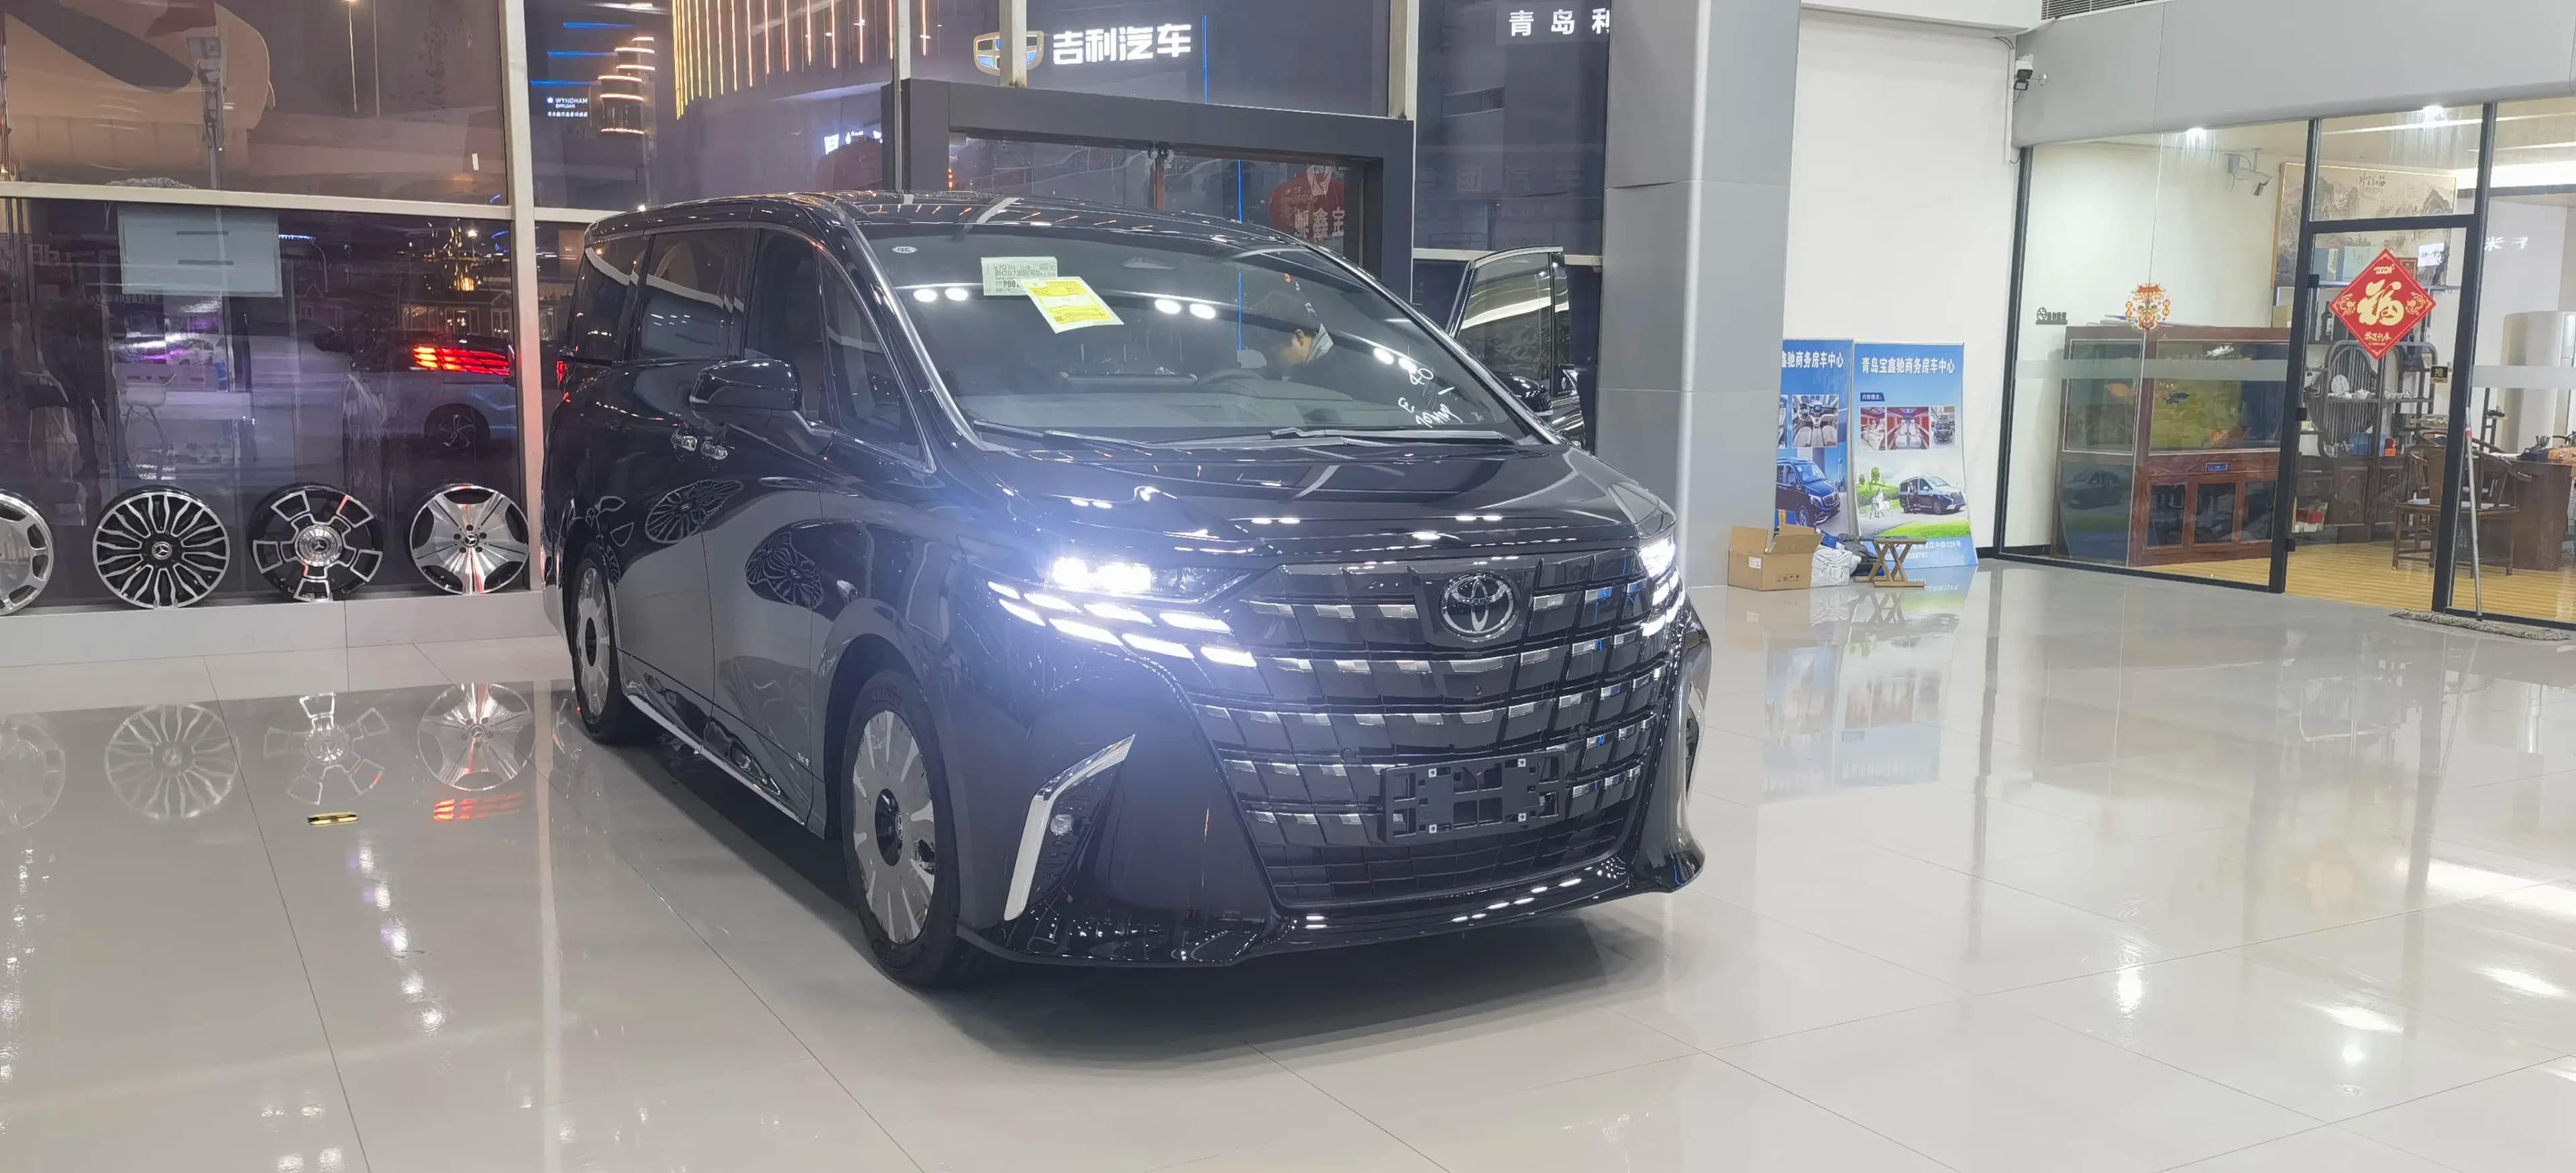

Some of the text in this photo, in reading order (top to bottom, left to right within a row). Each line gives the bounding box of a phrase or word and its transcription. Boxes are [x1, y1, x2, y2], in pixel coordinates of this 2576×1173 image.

[1053, 23, 1191, 65] 吉利汽车
[2357, 279, 2405, 325] 福
[1862, 356, 1955, 374] 青岛宝鑫驰商务房车中心
